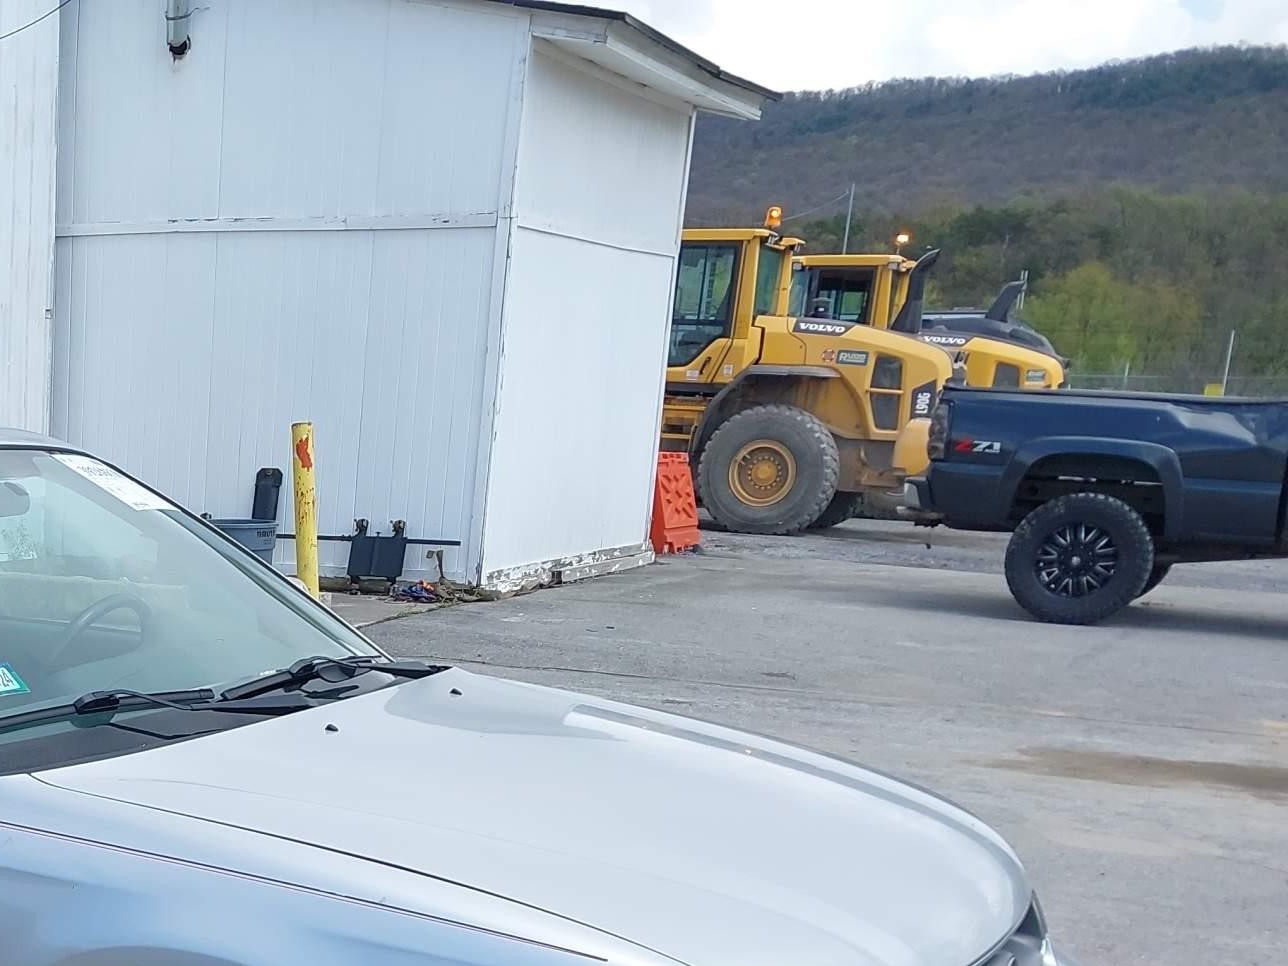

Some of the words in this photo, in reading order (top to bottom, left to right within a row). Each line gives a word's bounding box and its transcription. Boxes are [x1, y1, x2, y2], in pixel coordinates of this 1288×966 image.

[799, 322, 846, 333] VOLVO
[923, 335, 966, 345] VOLVO
[915, 392, 931, 414] L90G
[954, 439, 1001, 453] Z71
